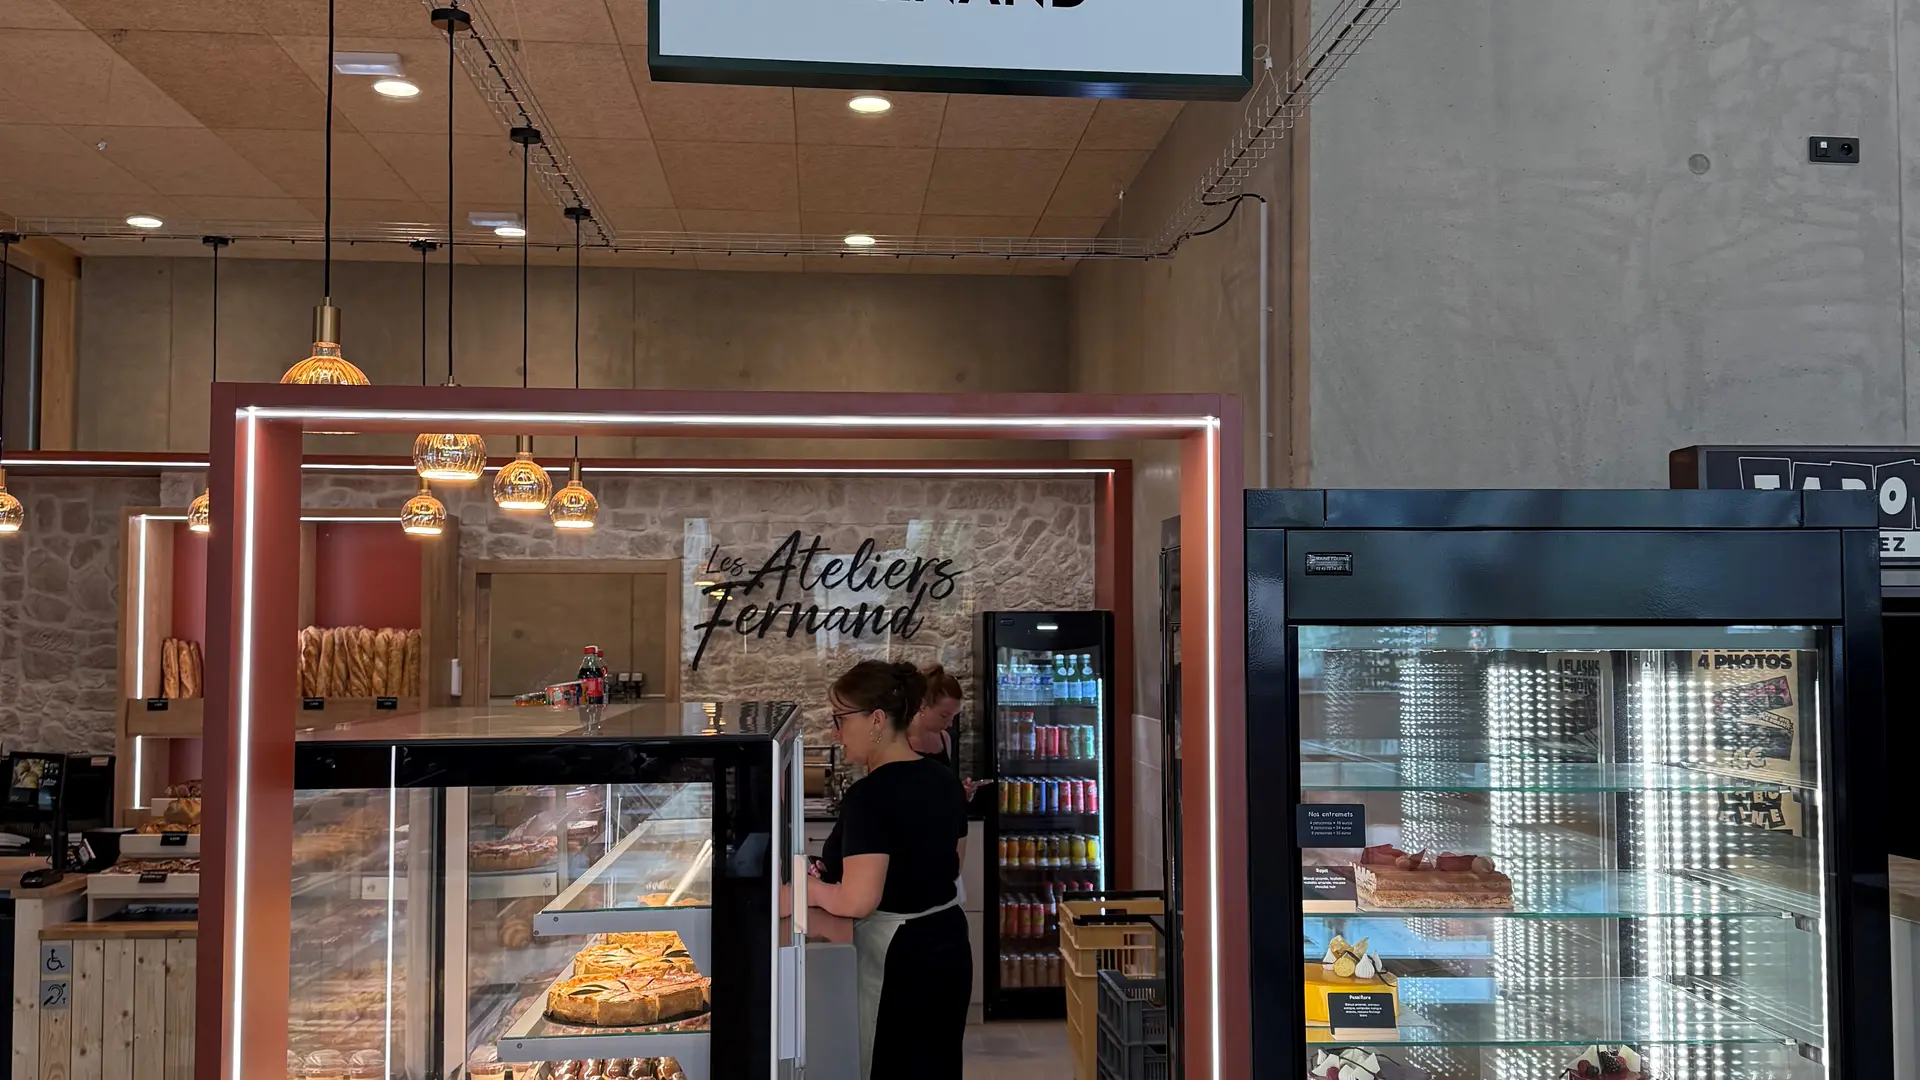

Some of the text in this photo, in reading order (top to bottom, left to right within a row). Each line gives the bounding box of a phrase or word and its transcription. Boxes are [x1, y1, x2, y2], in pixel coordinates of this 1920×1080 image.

[705, 529, 963, 601] Les Ateliers
[692, 579, 928, 671] Fernand
[1697, 653, 1793, 670] 4 PHOTOS
